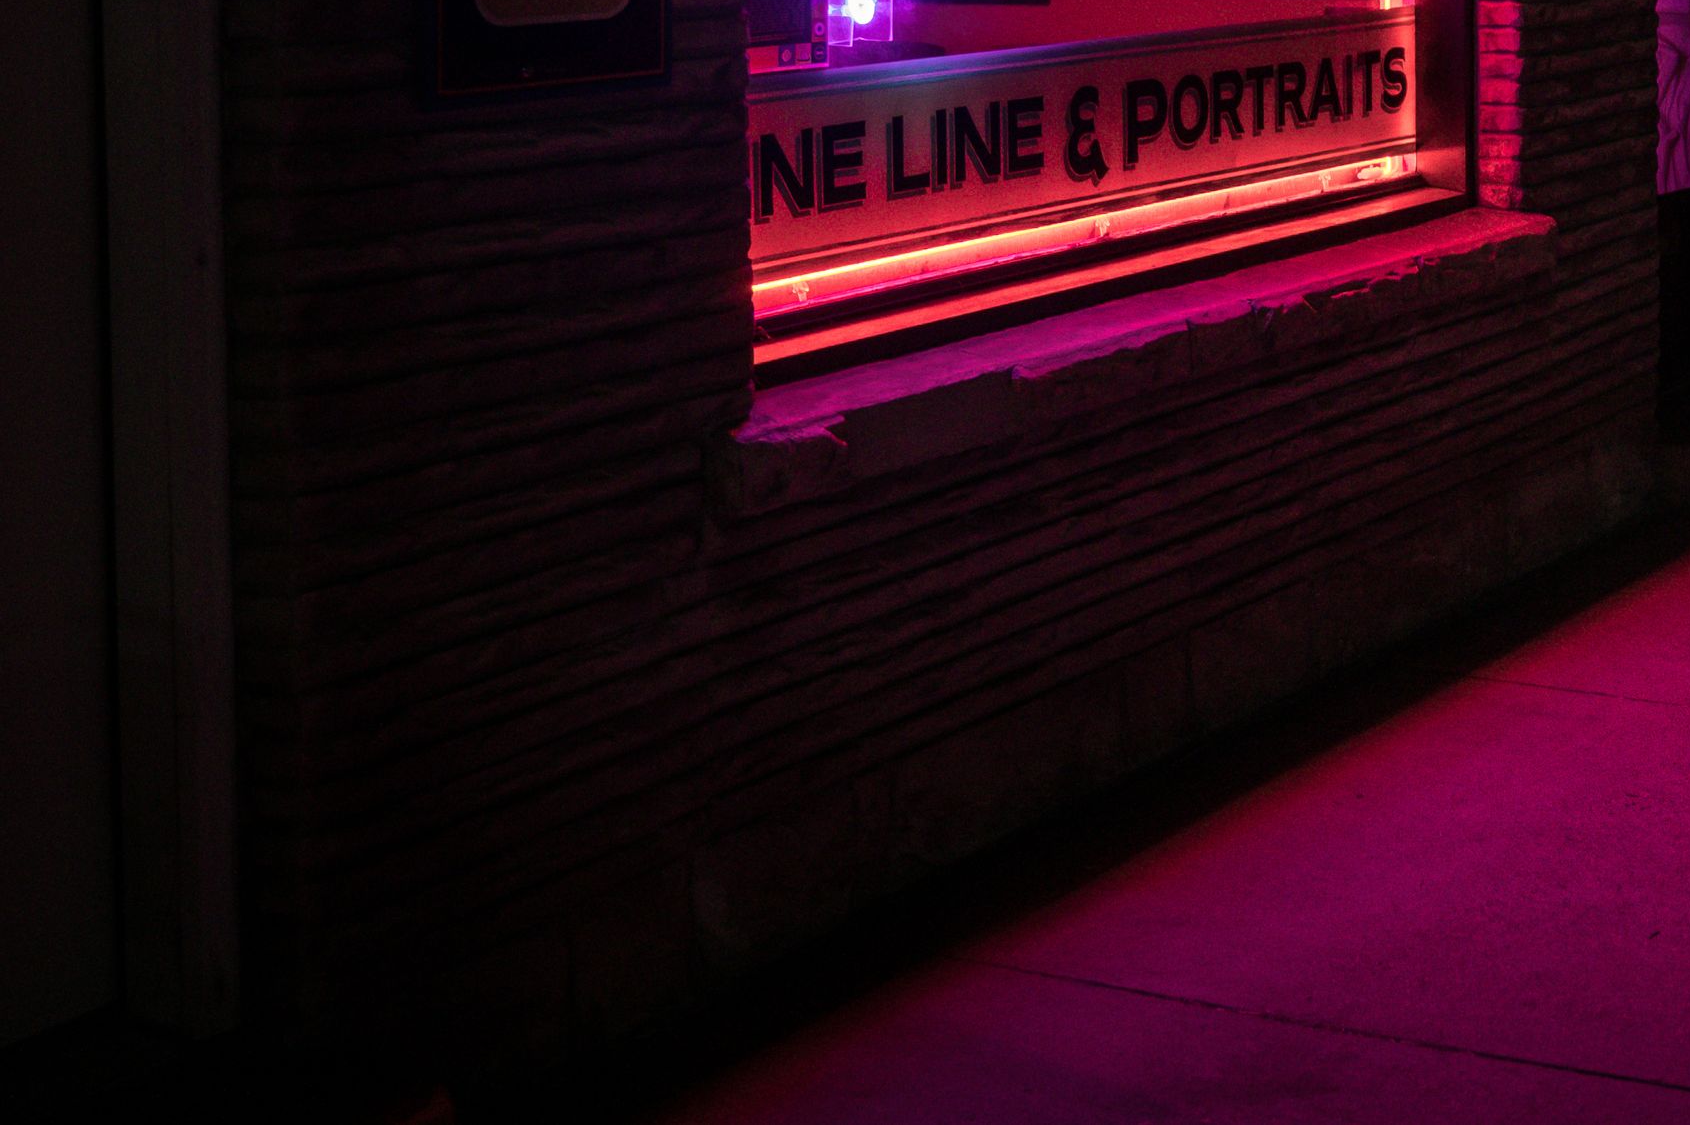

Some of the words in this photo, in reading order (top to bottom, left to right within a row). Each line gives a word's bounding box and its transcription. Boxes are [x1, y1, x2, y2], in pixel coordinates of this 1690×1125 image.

[754, 120, 866, 224] NE
[887, 95, 1045, 201] LINE
[1064, 86, 1110, 186] &
[1123, 47, 1407, 171] PORTRAITS
